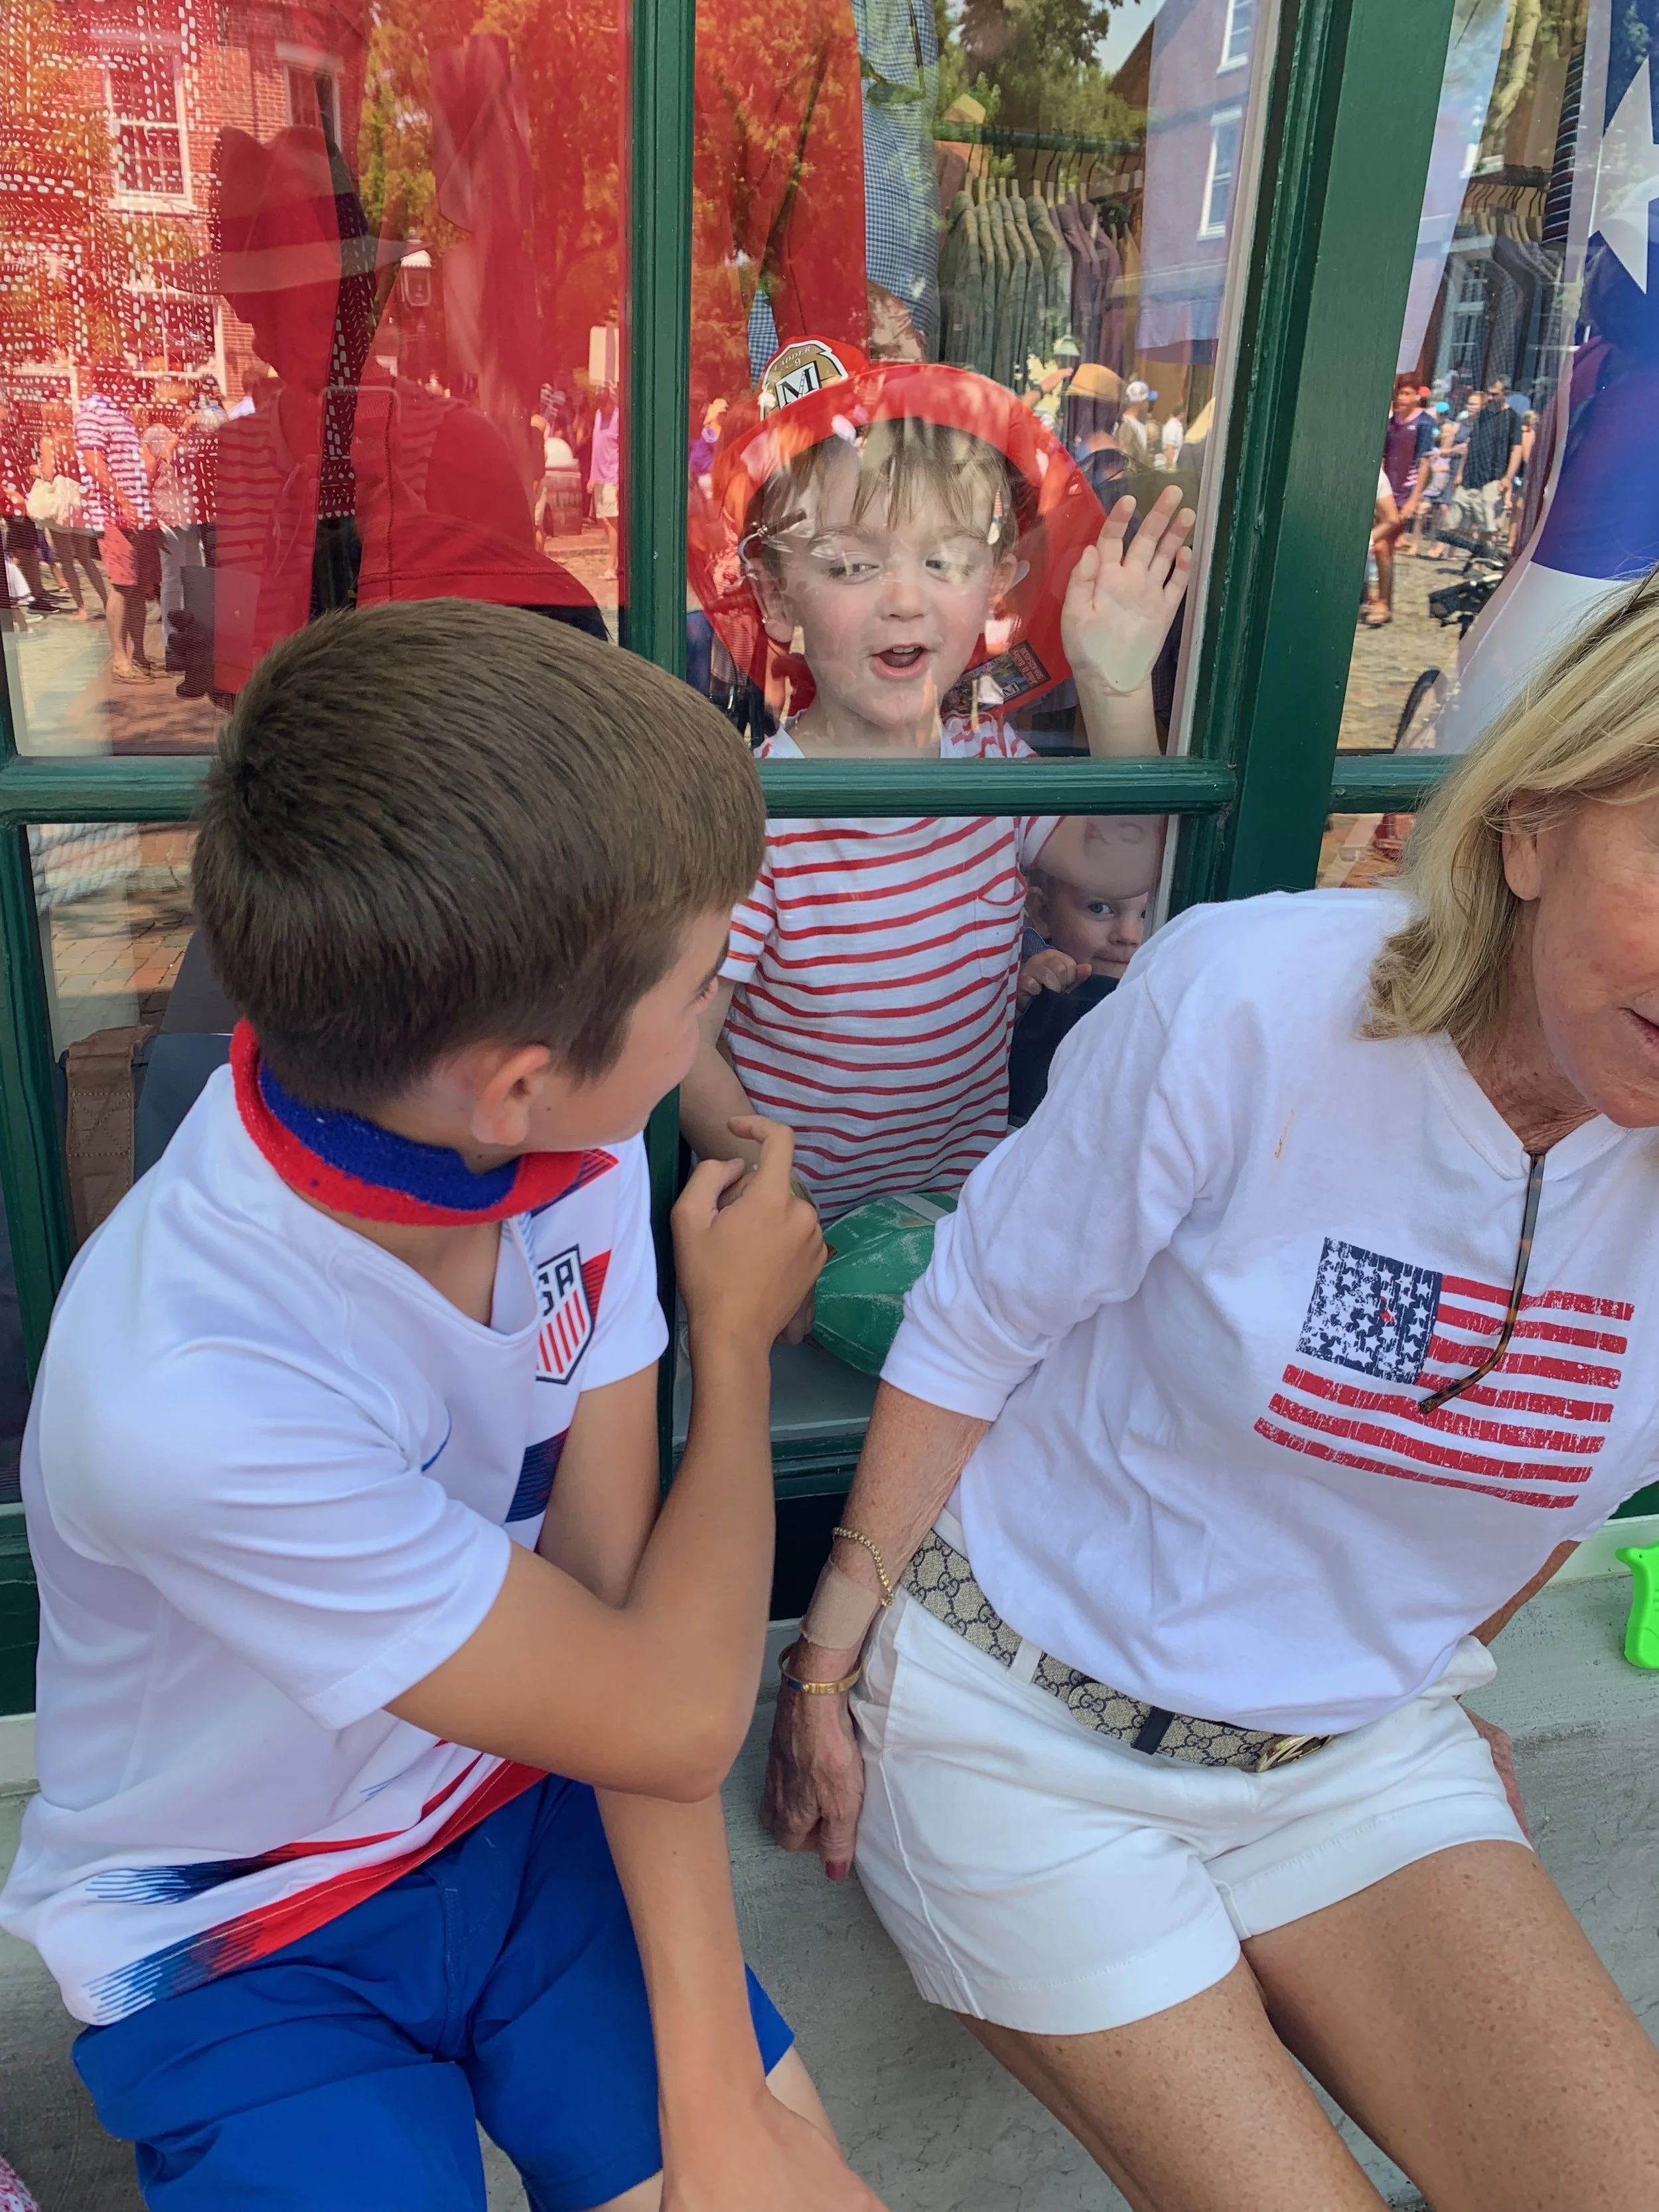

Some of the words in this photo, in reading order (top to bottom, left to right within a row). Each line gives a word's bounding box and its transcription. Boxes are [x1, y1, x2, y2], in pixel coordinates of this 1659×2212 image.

[774, 346, 811, 371] LADDER
[794, 358, 802, 366] 9
[538, 1258, 574, 1317] SA
